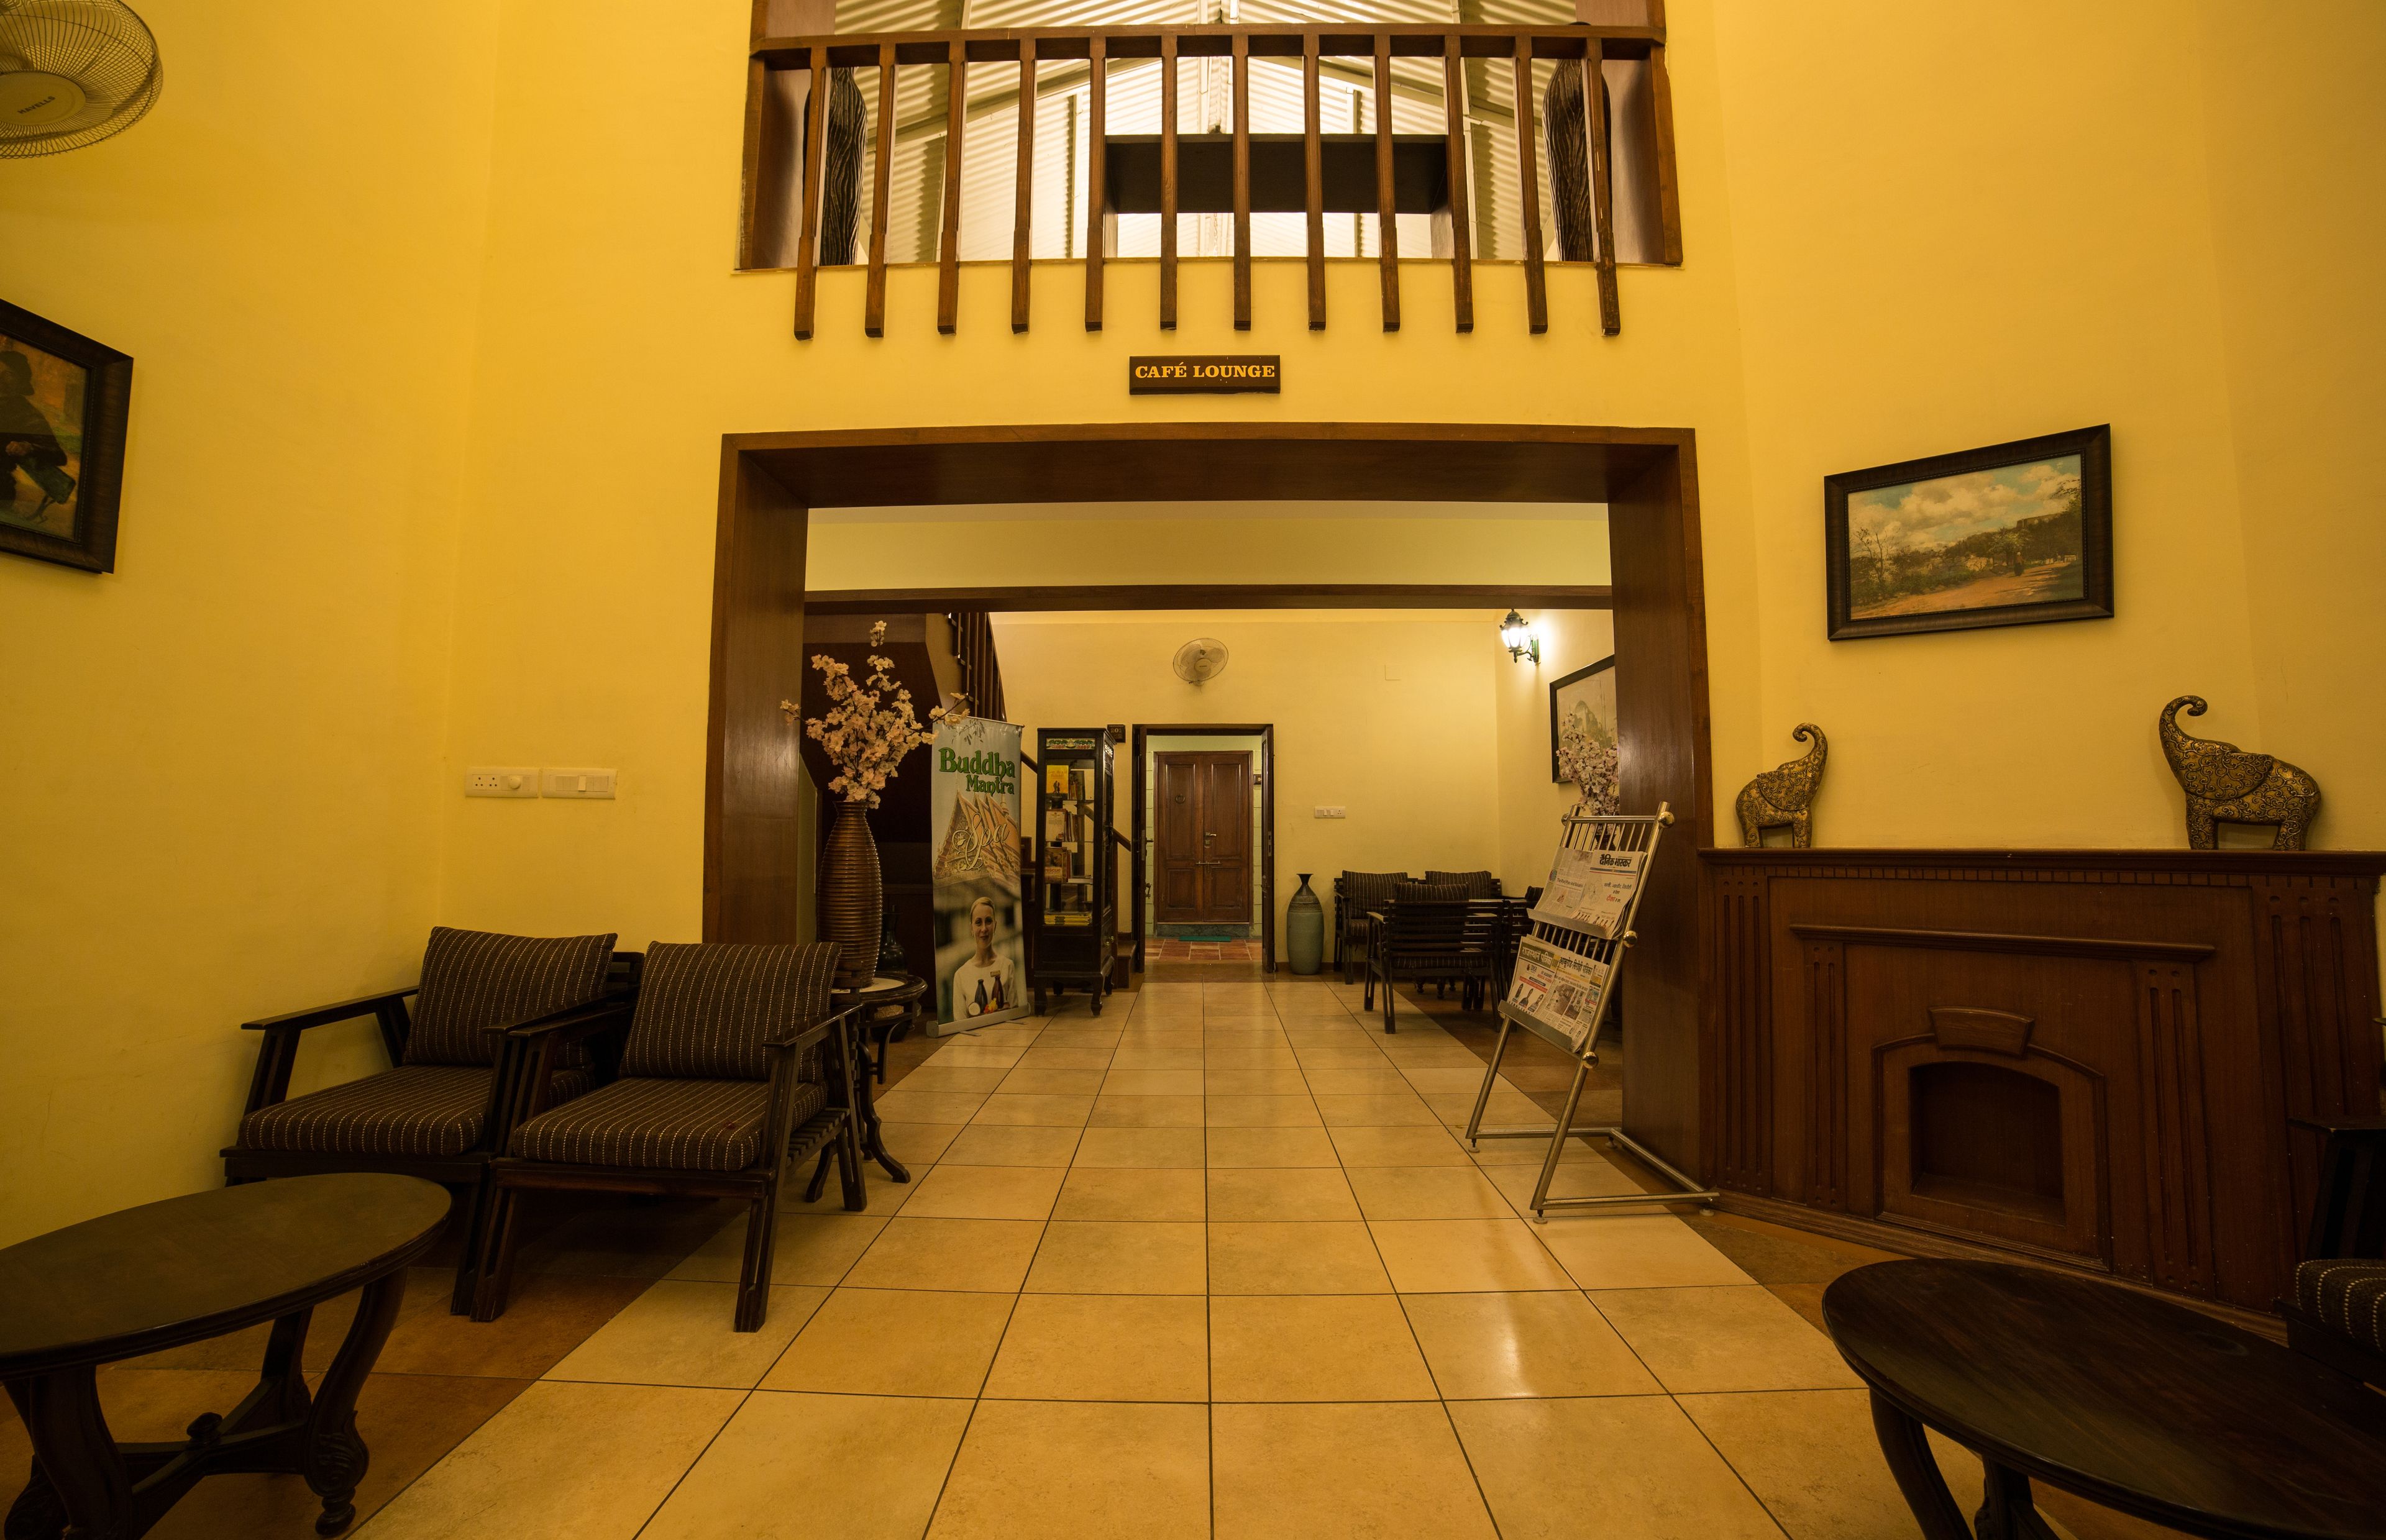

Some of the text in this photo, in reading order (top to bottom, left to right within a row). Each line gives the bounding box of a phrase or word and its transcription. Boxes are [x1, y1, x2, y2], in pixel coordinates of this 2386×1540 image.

[17, 96, 55, 114] HAVELLS
[1135, 362, 1275, 378] CAFÉ LOUNGE
[938, 747, 1015, 782] Buddha
[966, 775, 1015, 796] Mantra
[952, 813, 1010, 870] Spa
[1599, 854, 1632, 867] दैनिक भास्कर
[1522, 946, 1553, 966] राजस्थान पत्रिका
